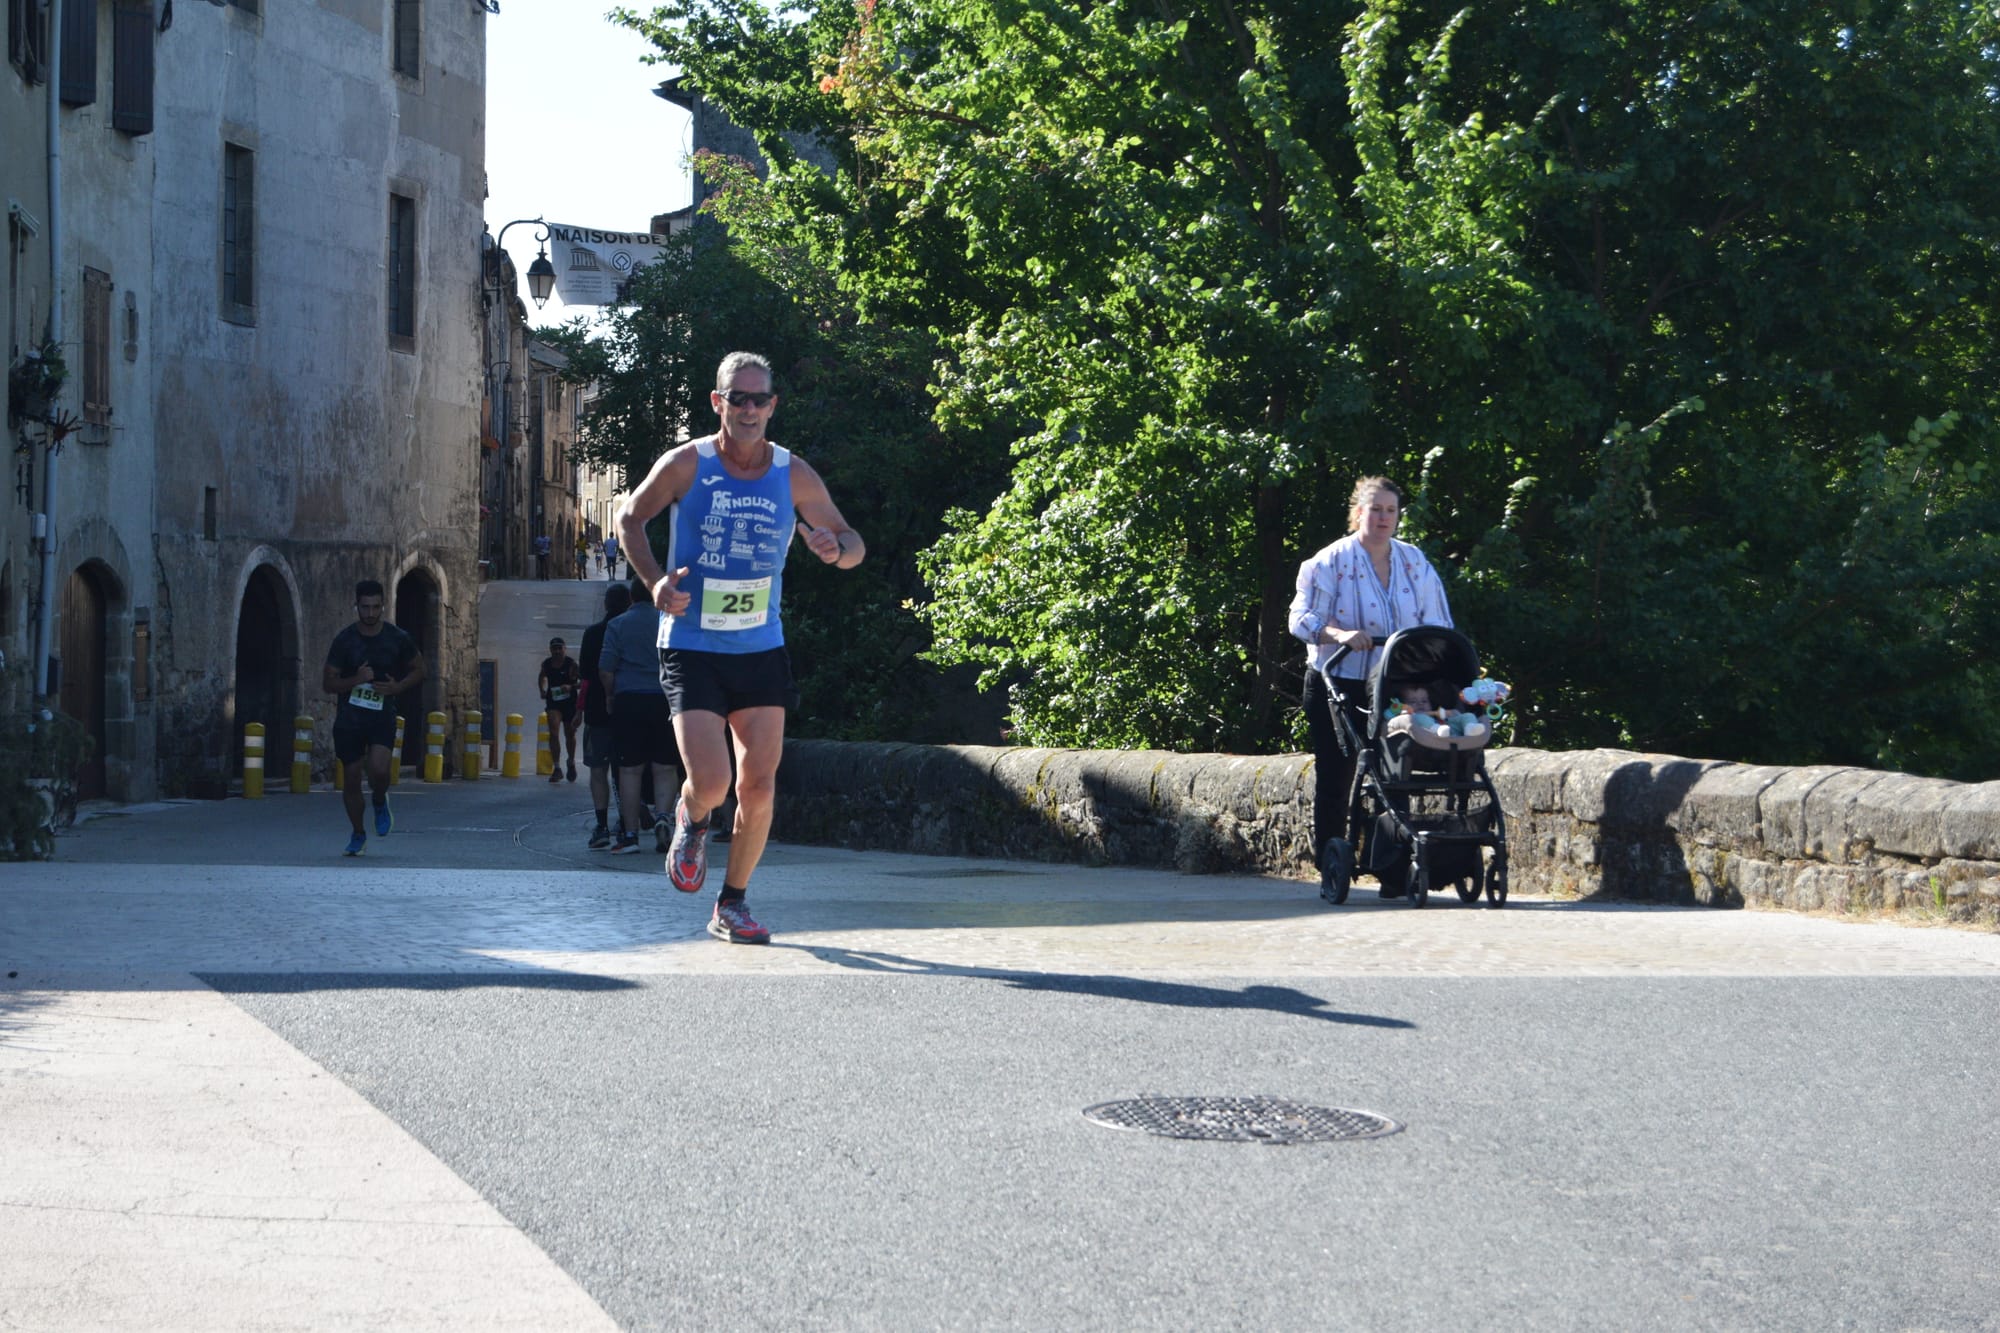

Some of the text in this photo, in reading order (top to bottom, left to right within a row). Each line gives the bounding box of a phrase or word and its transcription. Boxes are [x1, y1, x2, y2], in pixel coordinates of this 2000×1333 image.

[555, 228, 631, 244] MAISON
[637, 234, 660, 245] DE
[721, 593, 755, 613] 25
[357, 688, 380, 702] 155
